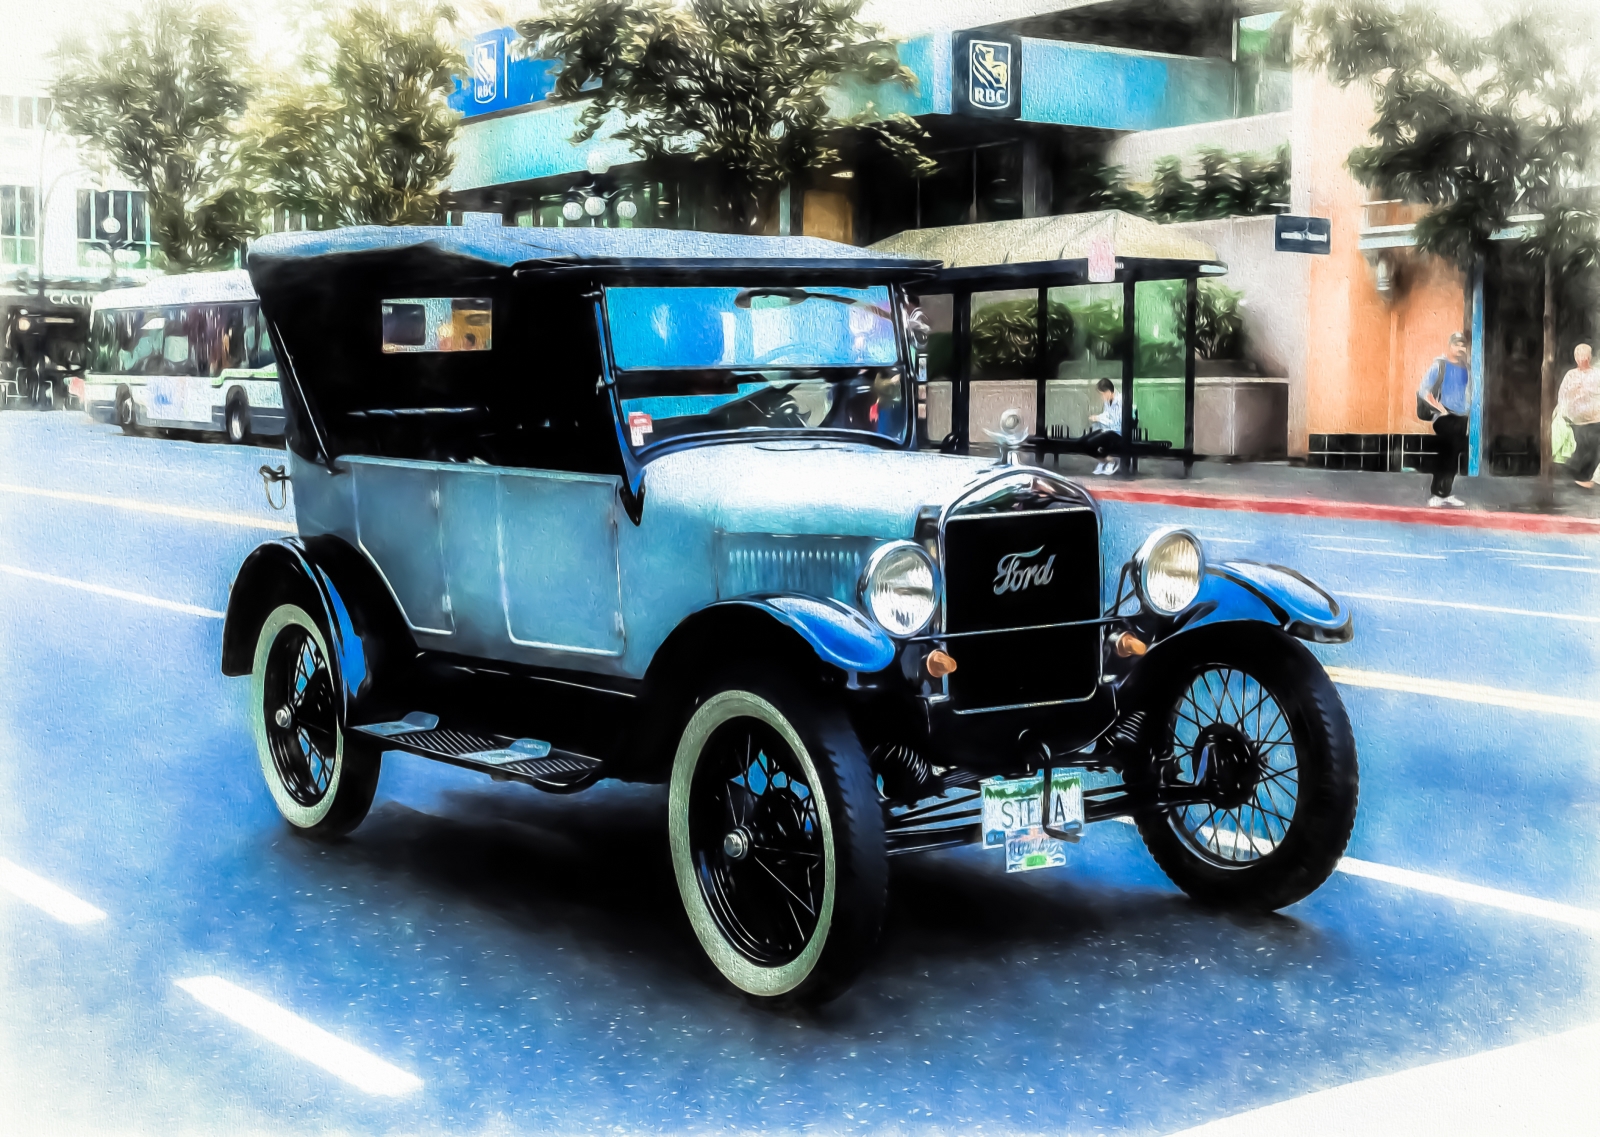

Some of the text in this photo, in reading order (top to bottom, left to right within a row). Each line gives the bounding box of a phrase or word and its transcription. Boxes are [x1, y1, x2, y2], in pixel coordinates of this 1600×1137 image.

[477, 83, 494, 98] RBC
[974, 87, 1006, 104] RBC
[993, 544, 1057, 595] Ford
